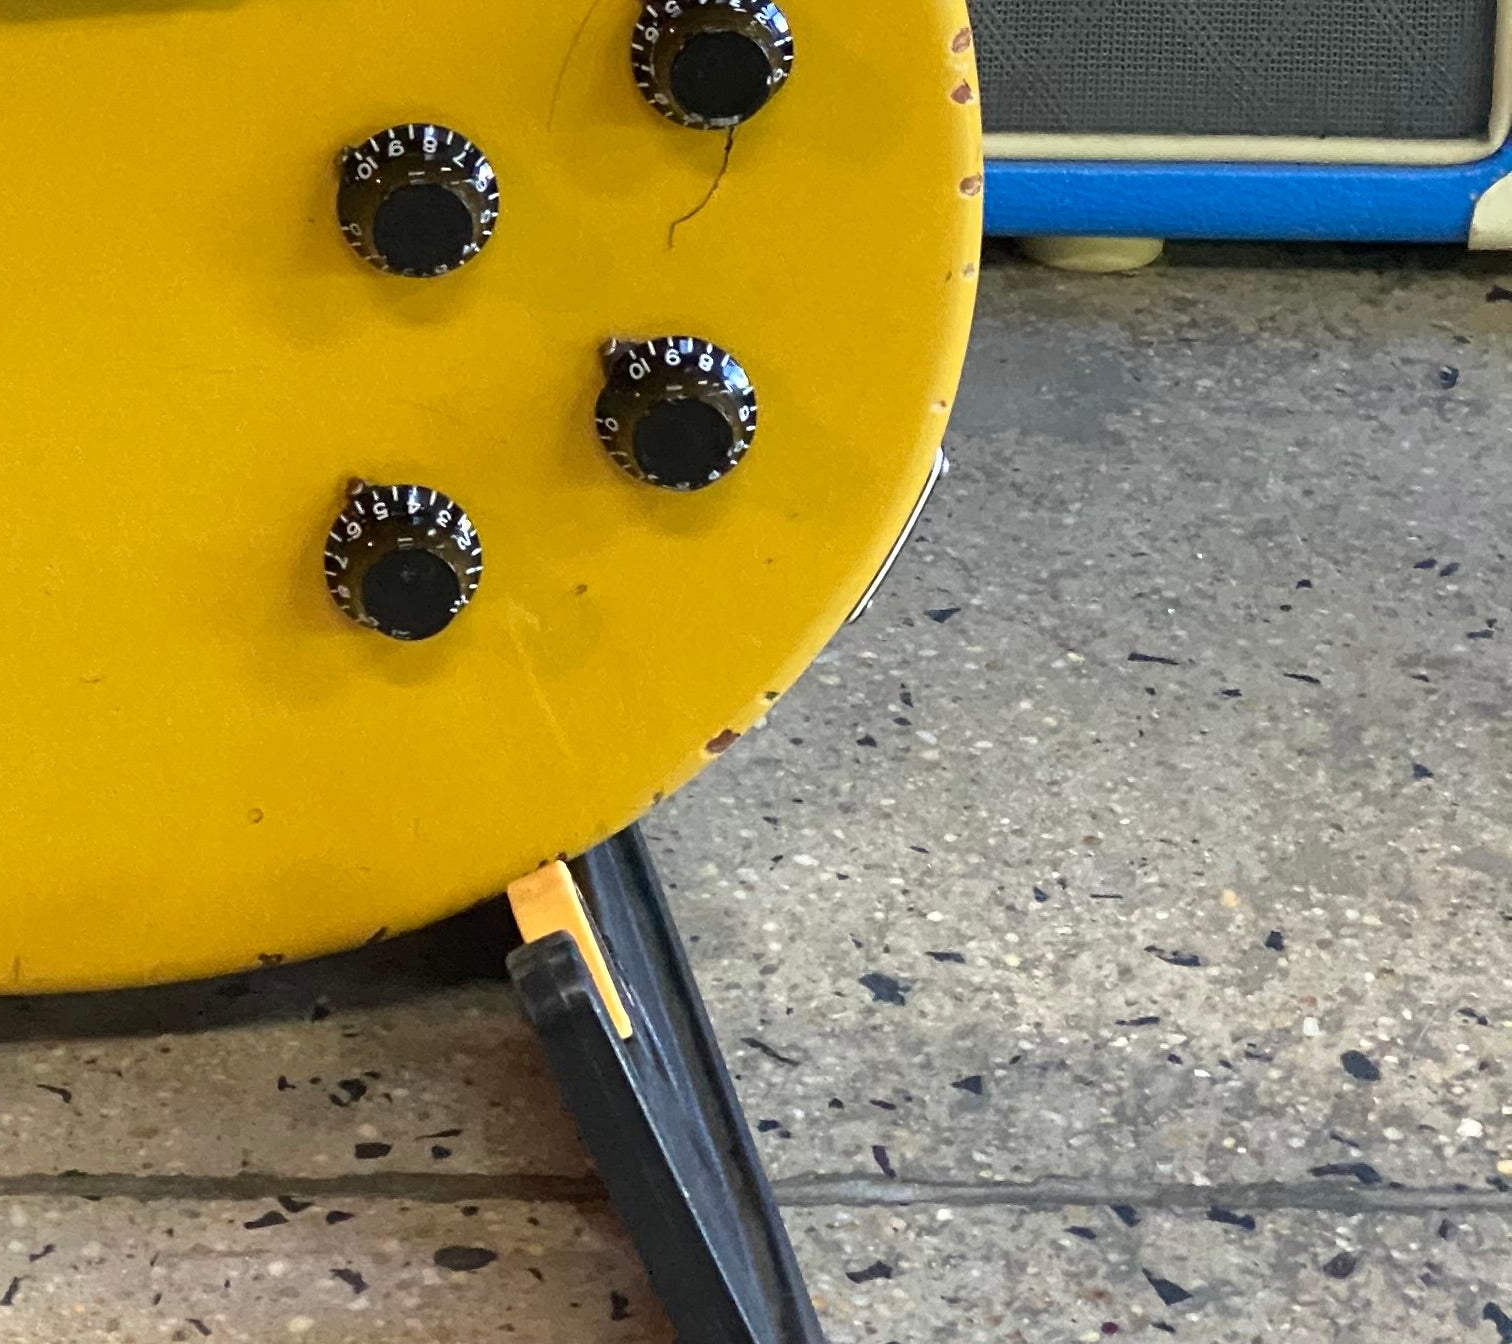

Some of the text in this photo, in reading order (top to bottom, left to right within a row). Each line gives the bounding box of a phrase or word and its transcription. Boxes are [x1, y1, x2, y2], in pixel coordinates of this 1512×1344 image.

[665, 0, 682, 17] 5
[388, 140, 405, 157] 9
[423, 137, 438, 153] 8
[357, 156, 379, 180] 10
[453, 152, 467, 168] 7
[629, 357, 651, 380] 10
[698, 353, 714, 372] 8
[373, 502, 389, 520] 5
[407, 499, 421, 514] 4
[436, 510, 452, 528] 3
[347, 521, 362, 542] 6
